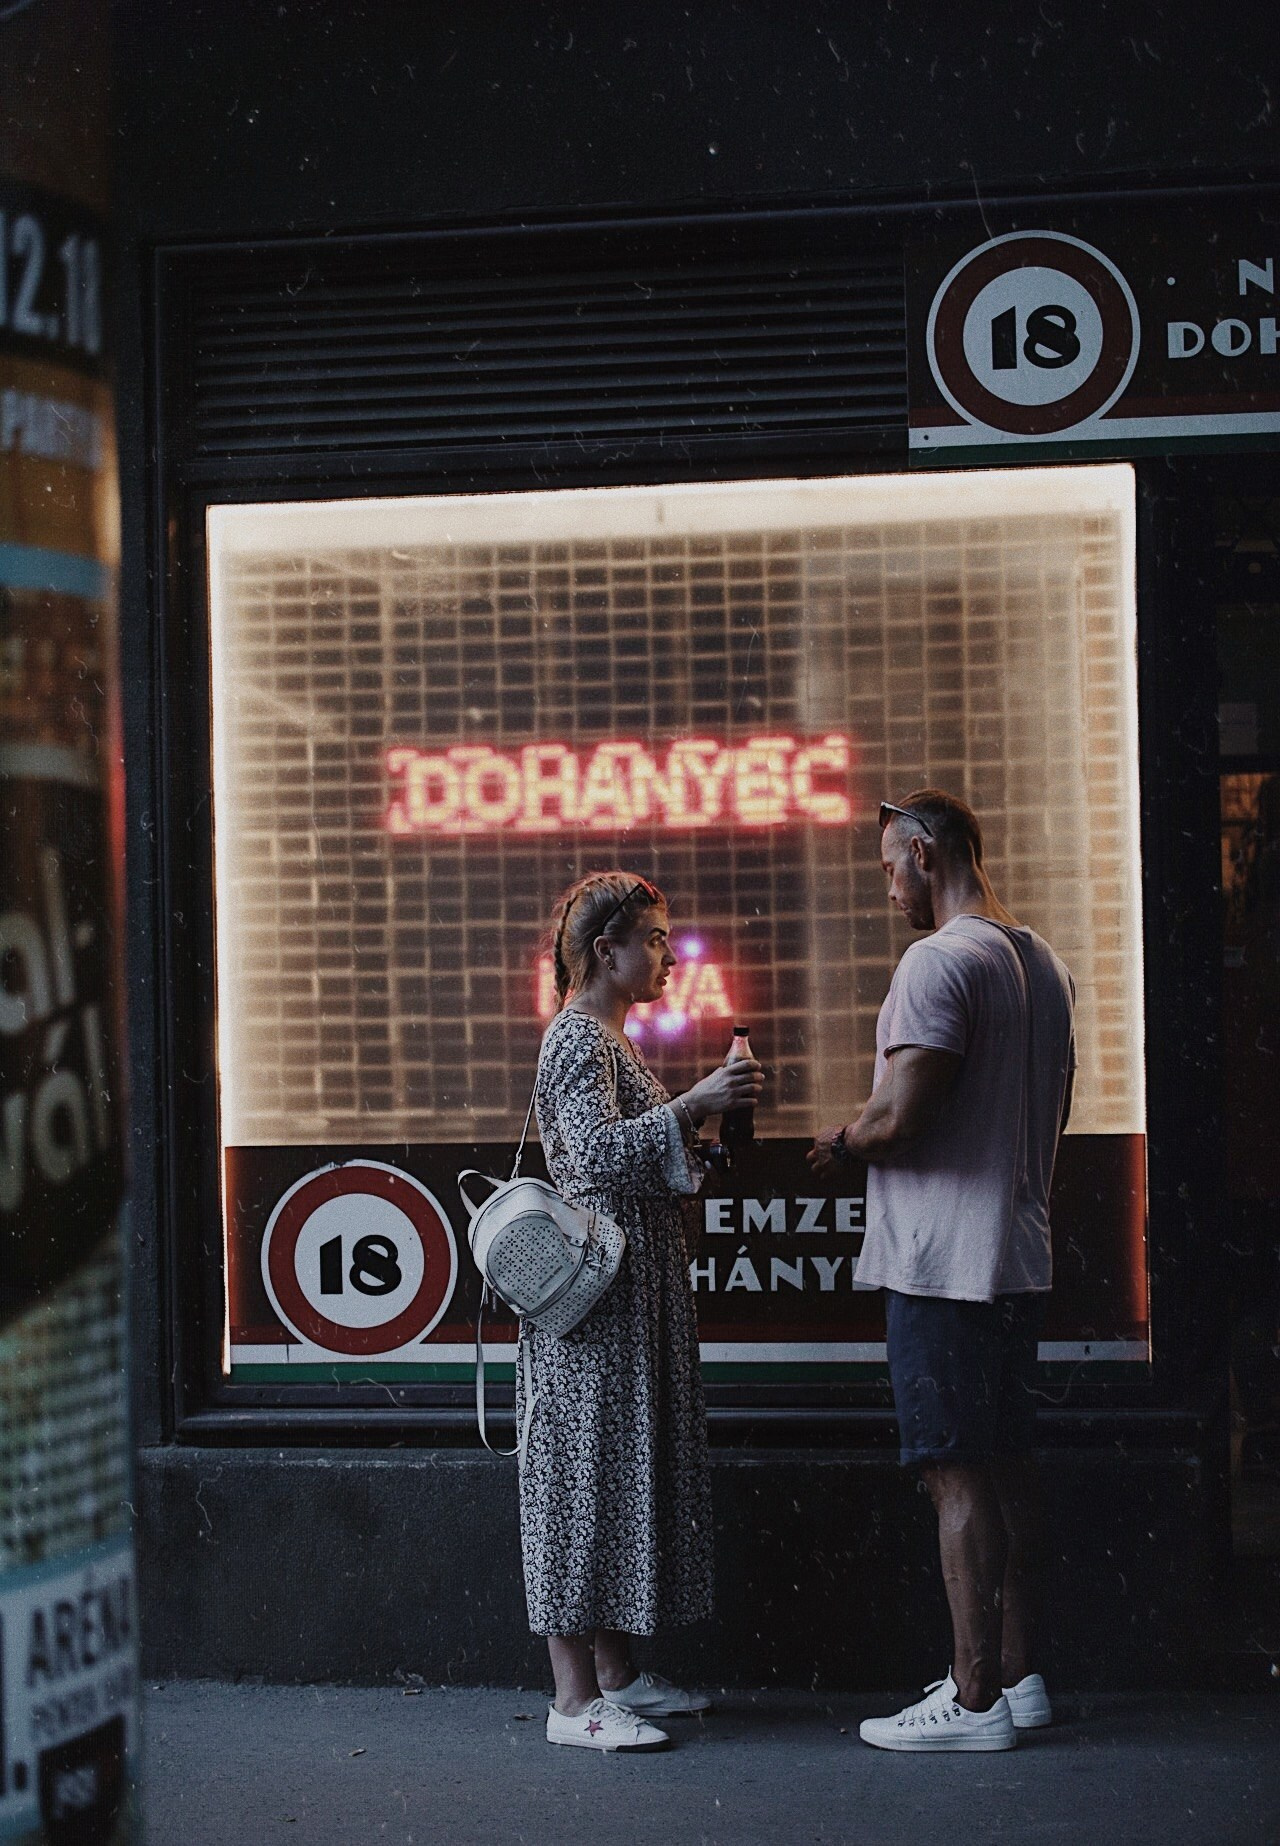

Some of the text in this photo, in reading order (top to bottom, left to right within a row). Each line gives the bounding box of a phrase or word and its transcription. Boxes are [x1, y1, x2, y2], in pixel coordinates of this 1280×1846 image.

[1238, 257, 1274, 296] N
[991, 304, 1081, 370] 18
[319, 1234, 402, 1296] 18
